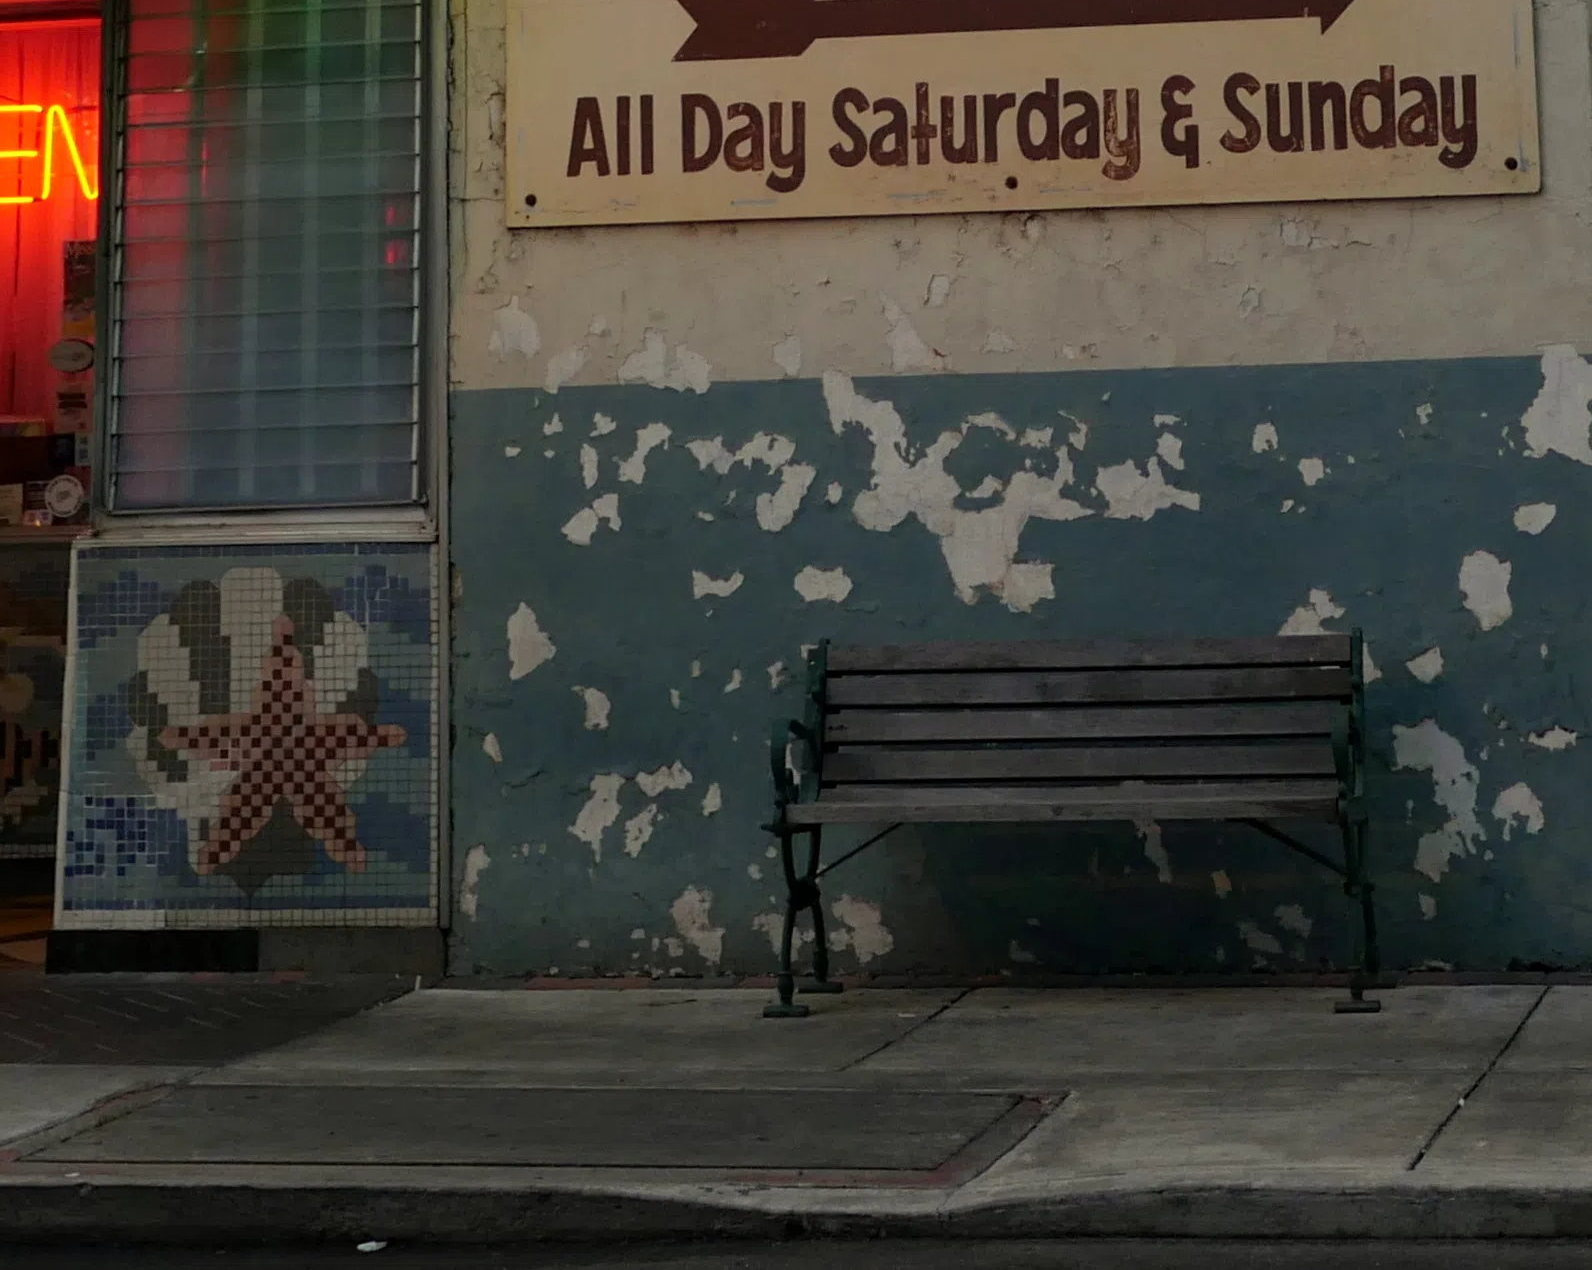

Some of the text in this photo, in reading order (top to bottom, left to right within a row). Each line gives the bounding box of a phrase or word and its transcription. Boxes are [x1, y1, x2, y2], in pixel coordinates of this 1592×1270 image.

[566, 64, 1479, 194] All Day Saturday & Sunday
